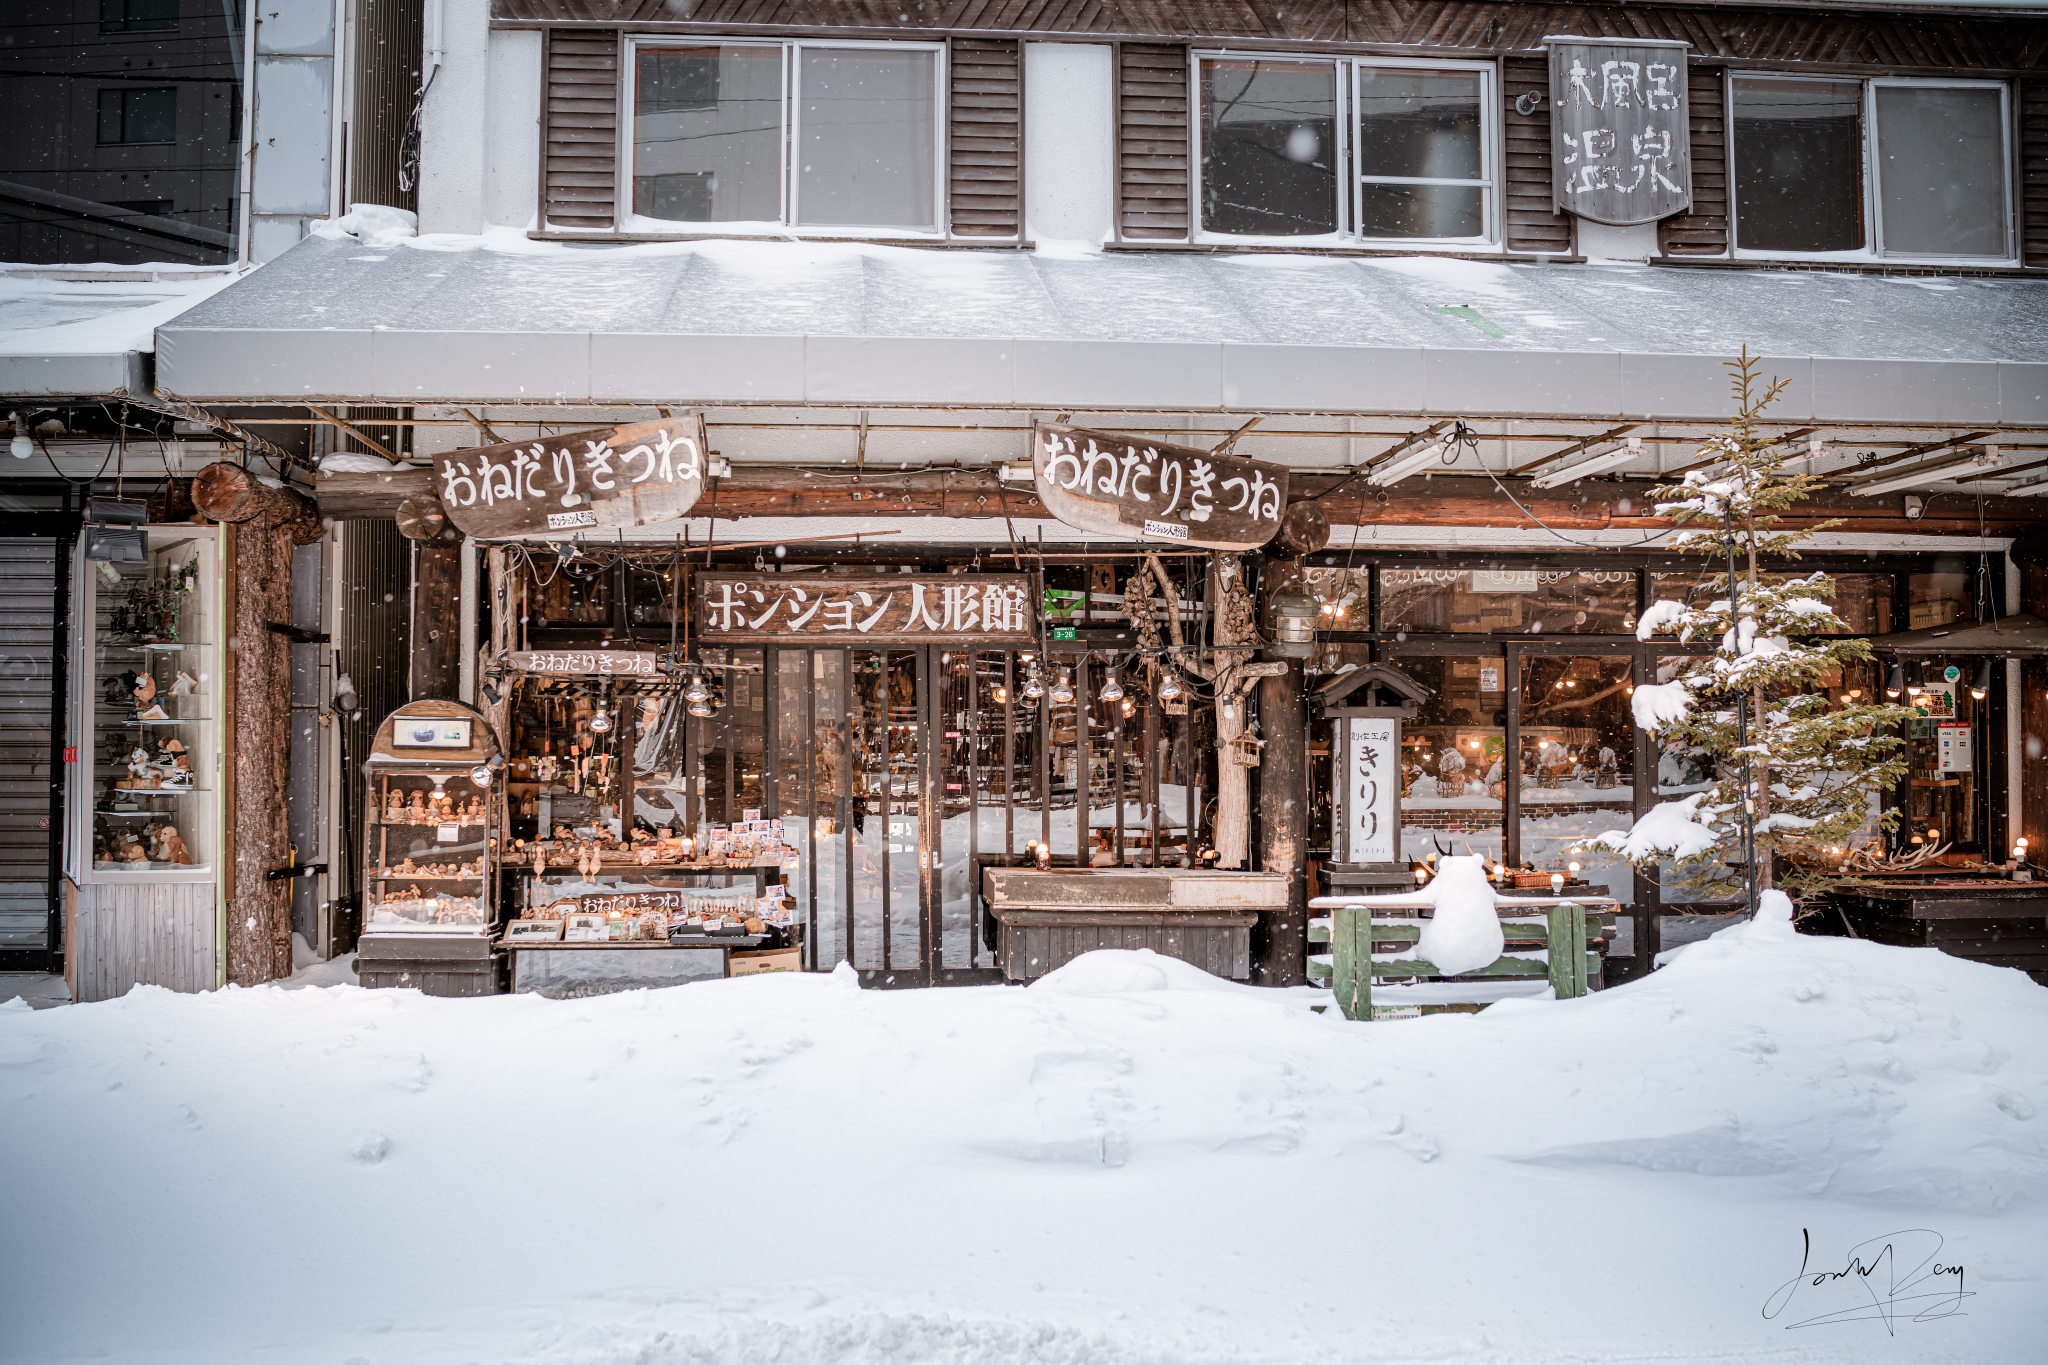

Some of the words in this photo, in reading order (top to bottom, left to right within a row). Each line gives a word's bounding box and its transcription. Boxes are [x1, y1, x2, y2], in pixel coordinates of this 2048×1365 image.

[1557, 59, 1681, 111] 木風呂
[1563, 125, 1684, 193] 温泉
[441, 429, 700, 507] おねだりきつね
[1043, 433, 1280, 522] おねだりきつね
[708, 582, 1025, 632] ポンション人形館
[529, 653, 653, 673] おねだりきつね
[1359, 745, 1379, 841] きりり
[583, 893, 680, 913] おねだりきつね
